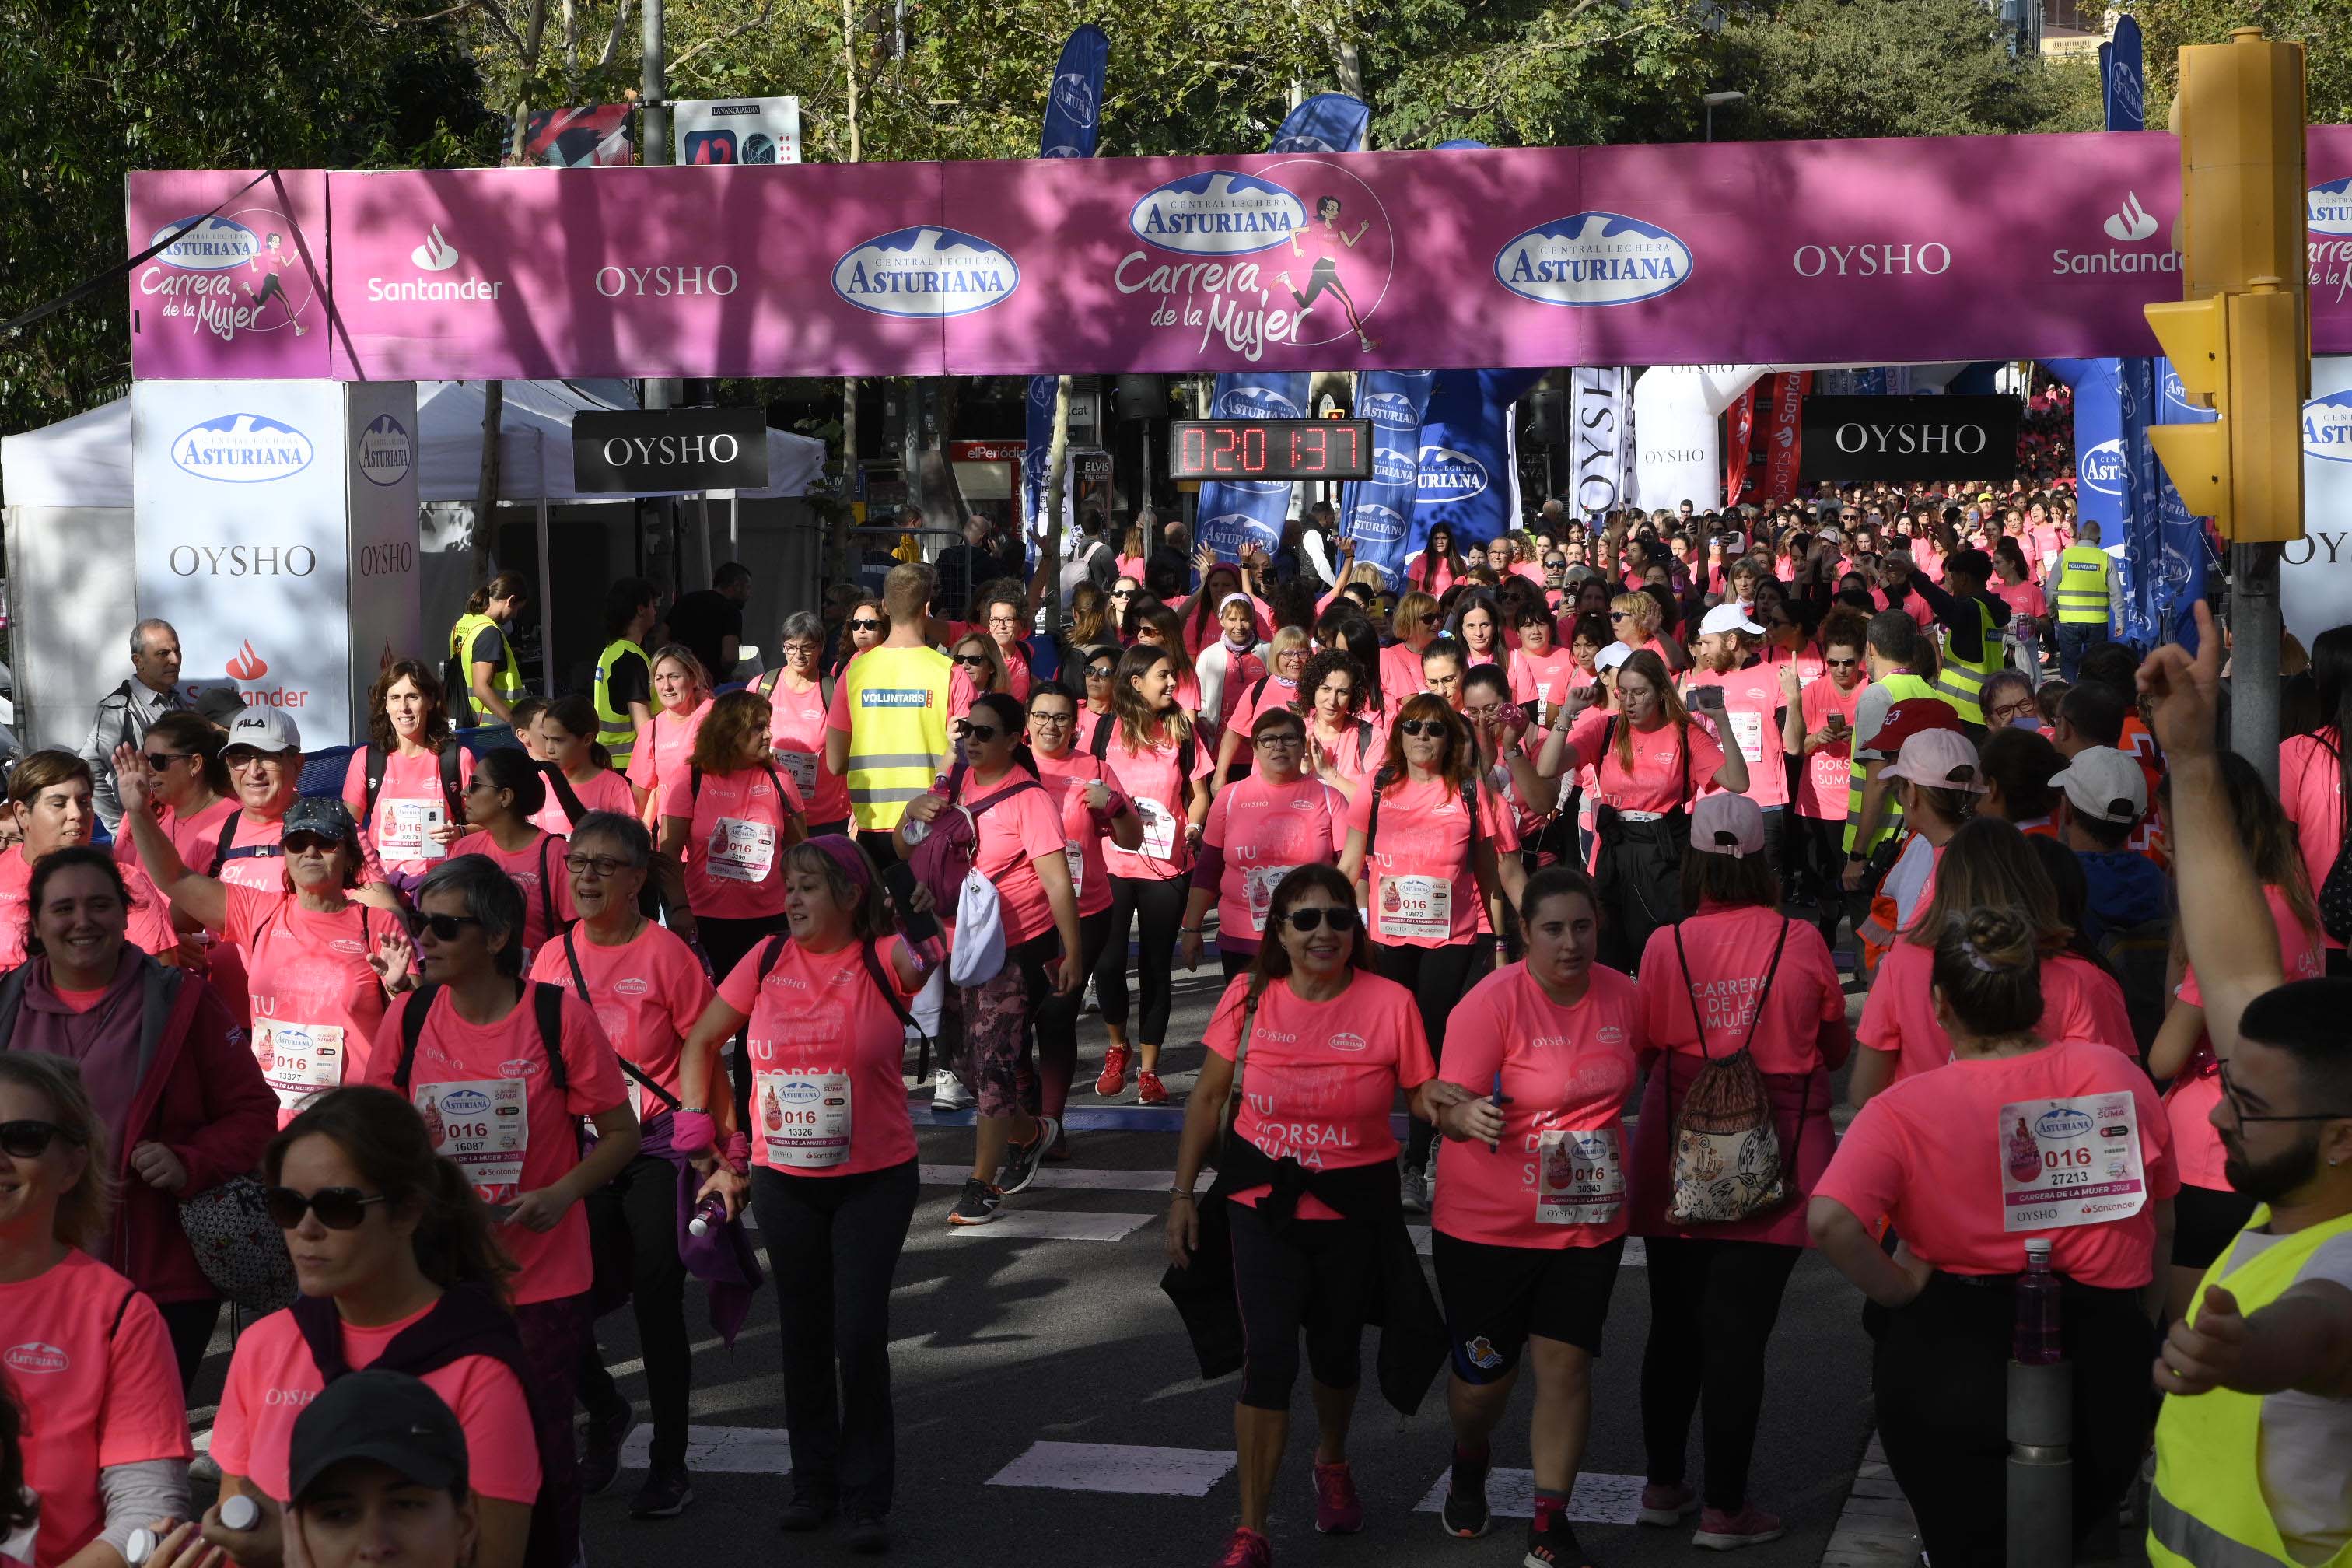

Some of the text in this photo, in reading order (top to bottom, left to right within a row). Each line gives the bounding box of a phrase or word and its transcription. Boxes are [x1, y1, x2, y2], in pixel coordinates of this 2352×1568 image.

[1171, 200, 1227, 208] CENTRAL
[1143, 203, 1293, 234] ASTURIANA
[159, 235, 250, 256] ASTURIANA
[1540, 243, 1671, 255] CENTRAL LECHERA
[875, 256, 999, 268] CENTRAL LECHERA
[1510, 249, 1678, 283] ASTURIANA
[1794, 242, 1951, 278] OYSHO
[140, 266, 231, 296] Carrera
[596, 265, 739, 297] OYSHO
[847, 261, 1005, 294] ASTURIANA
[1115, 251, 1259, 295] Carrera
[2326, 263, 2340, 285] la
[368, 276, 503, 303] Santander
[163, 293, 266, 341] de la Mujer
[1150, 289, 1314, 362] de la Mujer
[1836, 422, 1986, 454] OYSHO
[184, 439, 303, 464] ASTURIANA
[363, 444, 408, 468] ASTURIANA
[604, 433, 739, 467] OYSHO
[1645, 448, 1704, 464] OYSHO
[1085, 461, 1109, 471] ELVIS
[169, 545, 317, 576] OYSHO
[360, 542, 412, 576] OYSHO
[186, 684, 309, 708] Sander
[863, 693, 924, 704] VOLUNTARIS
[236, 719, 266, 732] FILA
[730, 842, 751, 853] 016
[1235, 845, 1256, 859] TU
[1374, 852, 1392, 868] TU
[1403, 900, 1426, 909] 016
[766, 974, 807, 990] OYSHO
[1692, 975, 1770, 997] CARRERA
[251, 995, 275, 1016] TU
[1708, 993, 1757, 1013] DE LA
[278, 1036, 310, 1047] ASTURIANA
[1257, 1027, 1297, 1044] OYSHO
[749, 1038, 772, 1060] TU
[277, 1055, 306, 1070] 016
[278, 1072, 302, 1082] 13327
[781, 1090, 817, 1099] ASTURIANA
[445, 1100, 487, 1110] ASTURIANA
[1248, 1093, 1273, 1115] TU
[785, 1111, 816, 1124] 016
[2098, 1110, 2125, 1118] SUMA
[448, 1122, 488, 1139] 016
[789, 1128, 813, 1136] 13326
[2039, 1120, 2089, 1133] ASTURIANA
[454, 1142, 485, 1152] 16087
[772, 1149, 793, 1158] OYSHO
[2045, 1147, 2091, 1168] 016
[1575, 1167, 1605, 1181] 016
[2052, 1171, 2088, 1185] 27213
[1577, 1185, 1601, 1194] 30343
[2019, 1192, 2055, 1202] CARRERA
[2112, 1184, 2130, 1192] 2023
[2017, 1209, 2058, 1222] OYSHO
[2093, 1201, 2136, 1213] Santander
[9, 1349, 64, 1368] ASTURIANA
